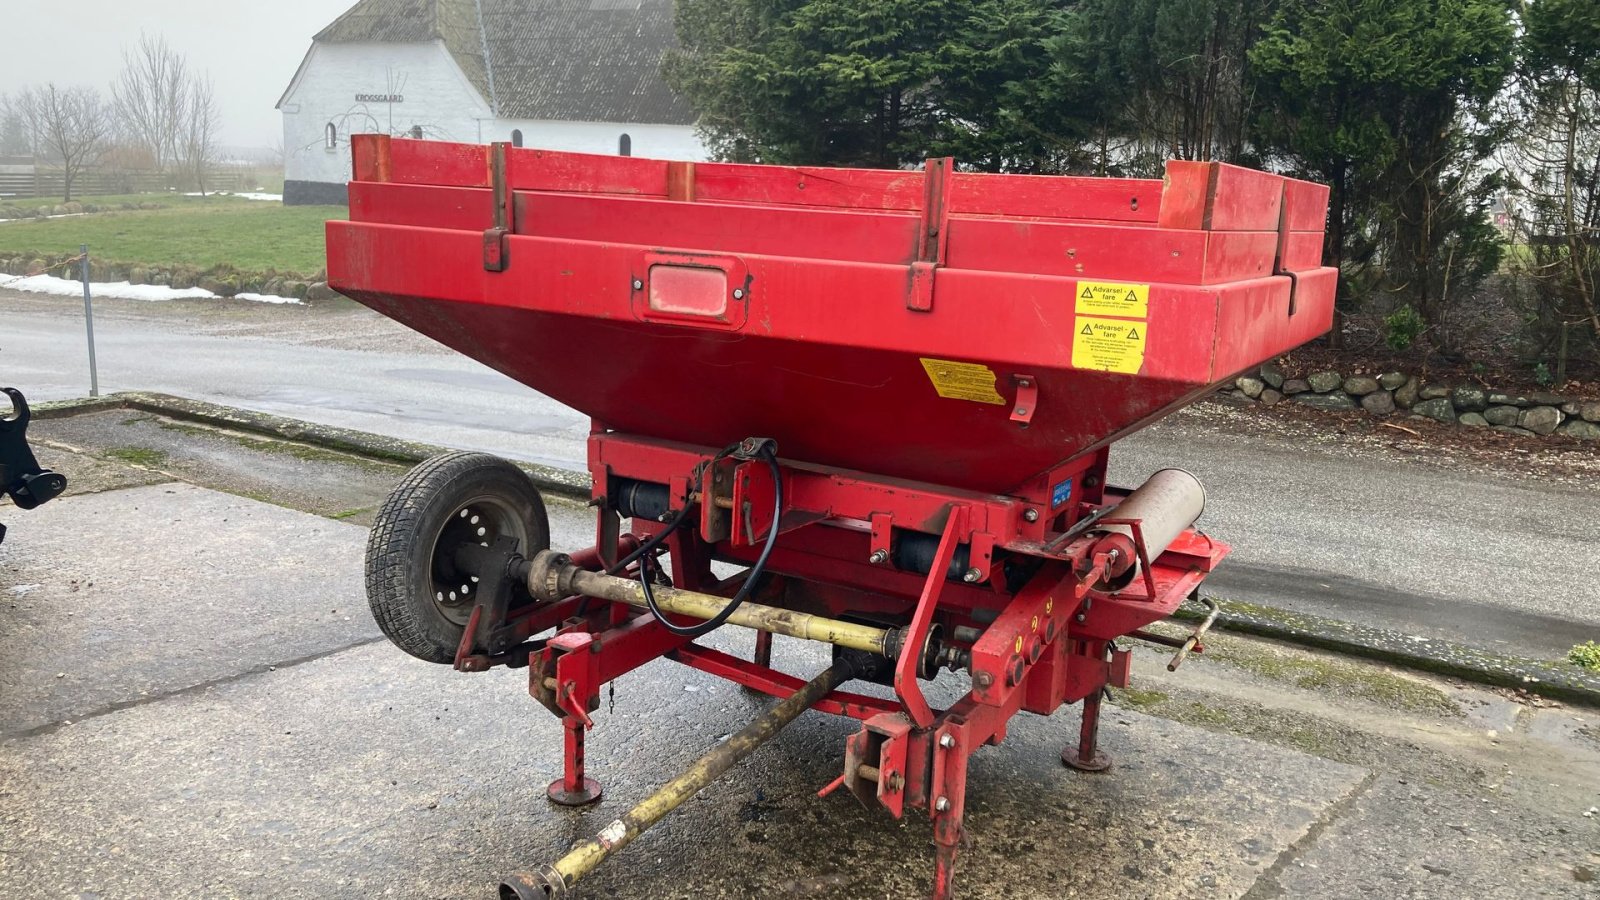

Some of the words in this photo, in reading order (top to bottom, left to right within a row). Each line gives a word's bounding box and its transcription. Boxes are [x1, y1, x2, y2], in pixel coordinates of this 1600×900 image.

[355, 94, 404, 102] KROGSGAARD
[1093, 286, 1123, 294] Advarsel
[1094, 323, 1124, 332] Advarsel
